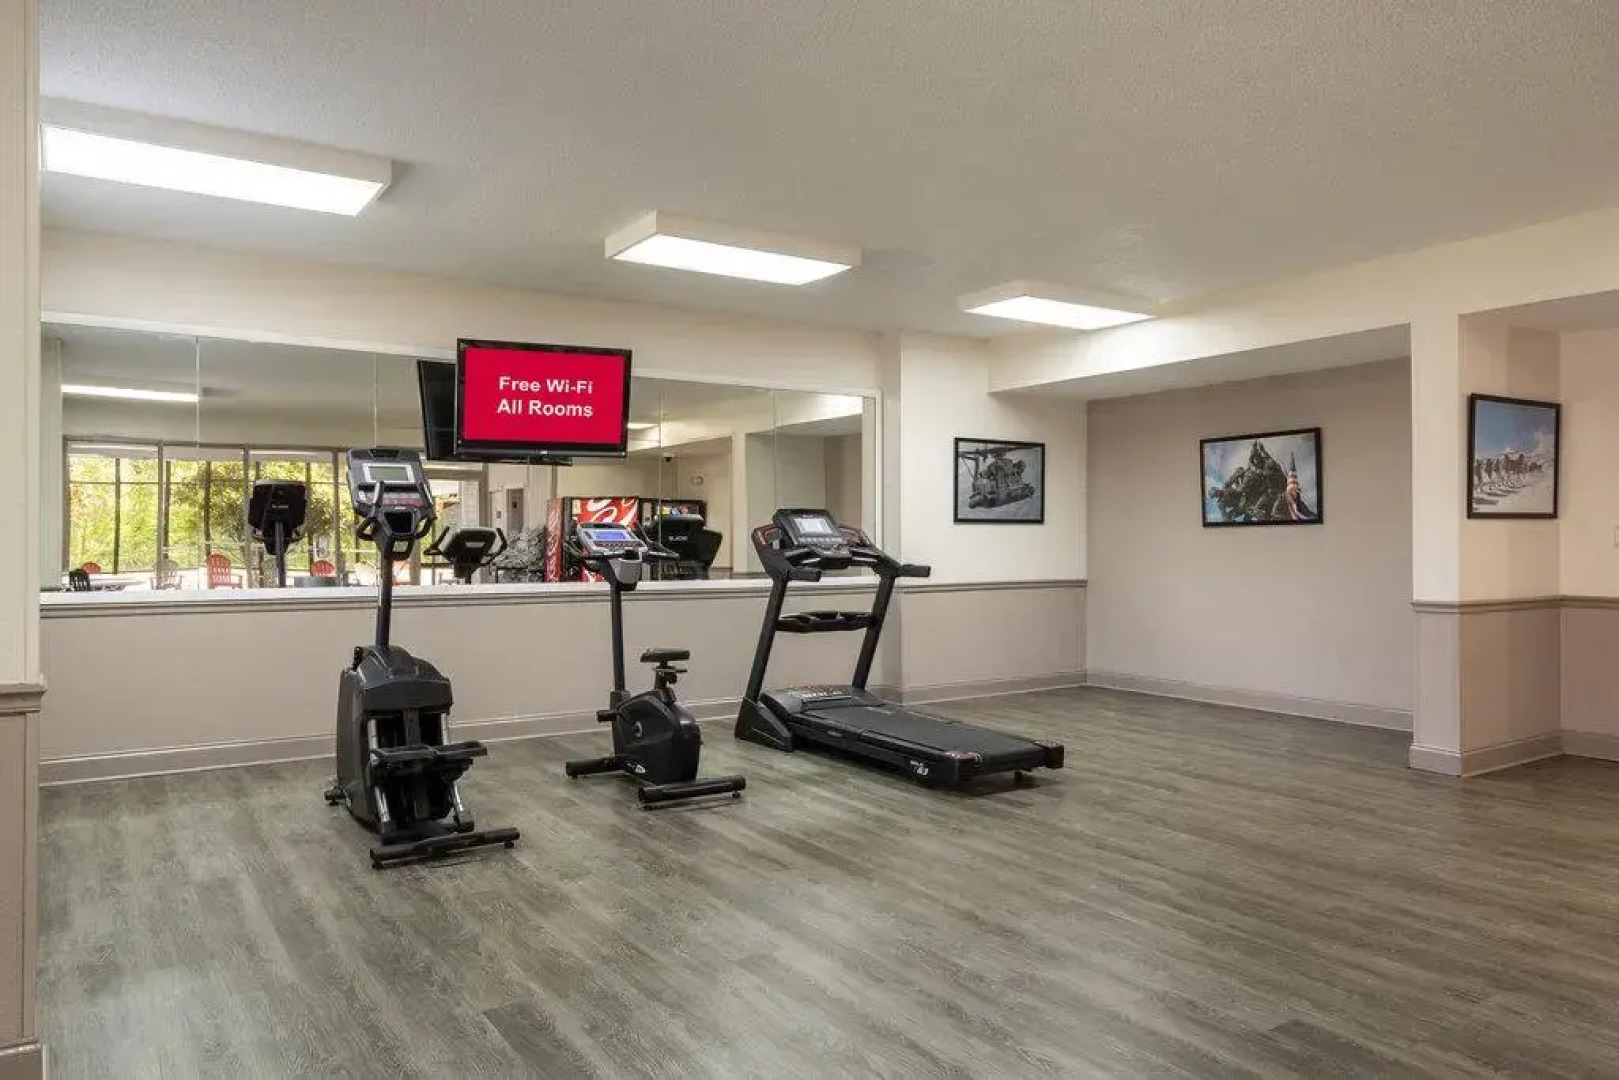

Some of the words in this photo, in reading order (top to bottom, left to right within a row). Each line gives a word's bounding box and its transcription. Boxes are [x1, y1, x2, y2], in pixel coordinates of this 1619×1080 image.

[498, 376, 541, 392] Free
[546, 379, 593, 395] Wi-Fi
[497, 399, 523, 415] All
[529, 400, 594, 417] Rooms
